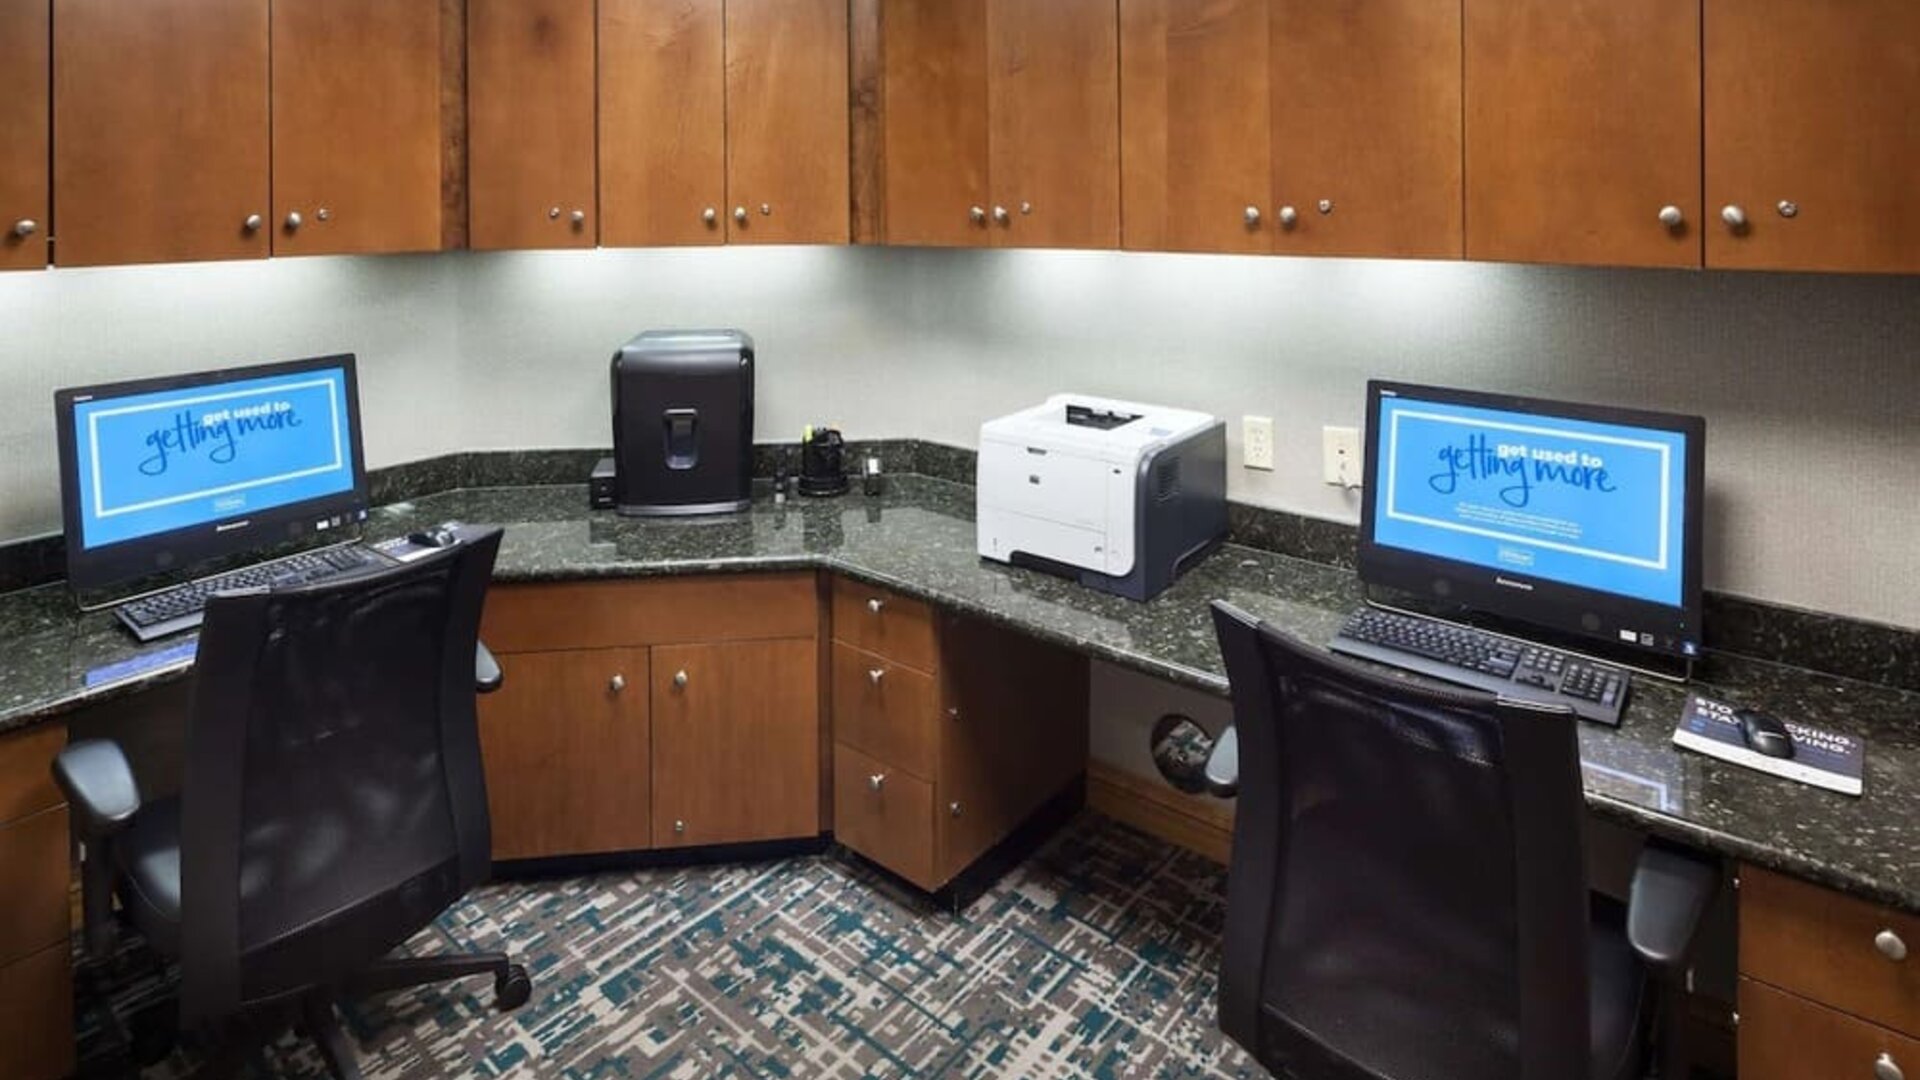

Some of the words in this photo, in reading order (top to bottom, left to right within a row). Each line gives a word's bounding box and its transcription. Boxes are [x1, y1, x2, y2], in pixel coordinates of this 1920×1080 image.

[202, 409, 231, 427] get
[233, 402, 271, 419] used
[273, 400, 291, 413] to
[138, 410, 236, 476] getting
[236, 409, 303, 436] more
[1496, 443, 1528, 460] get
[1531, 447, 1578, 466] used
[1581, 452, 1603, 469] to
[1428, 432, 1534, 508] getting
[1535, 459, 1617, 493] more
[1695, 697, 1734, 715] STO
[1784, 722, 1857, 748] CKING.
[1790, 732, 1851, 754] VING.
